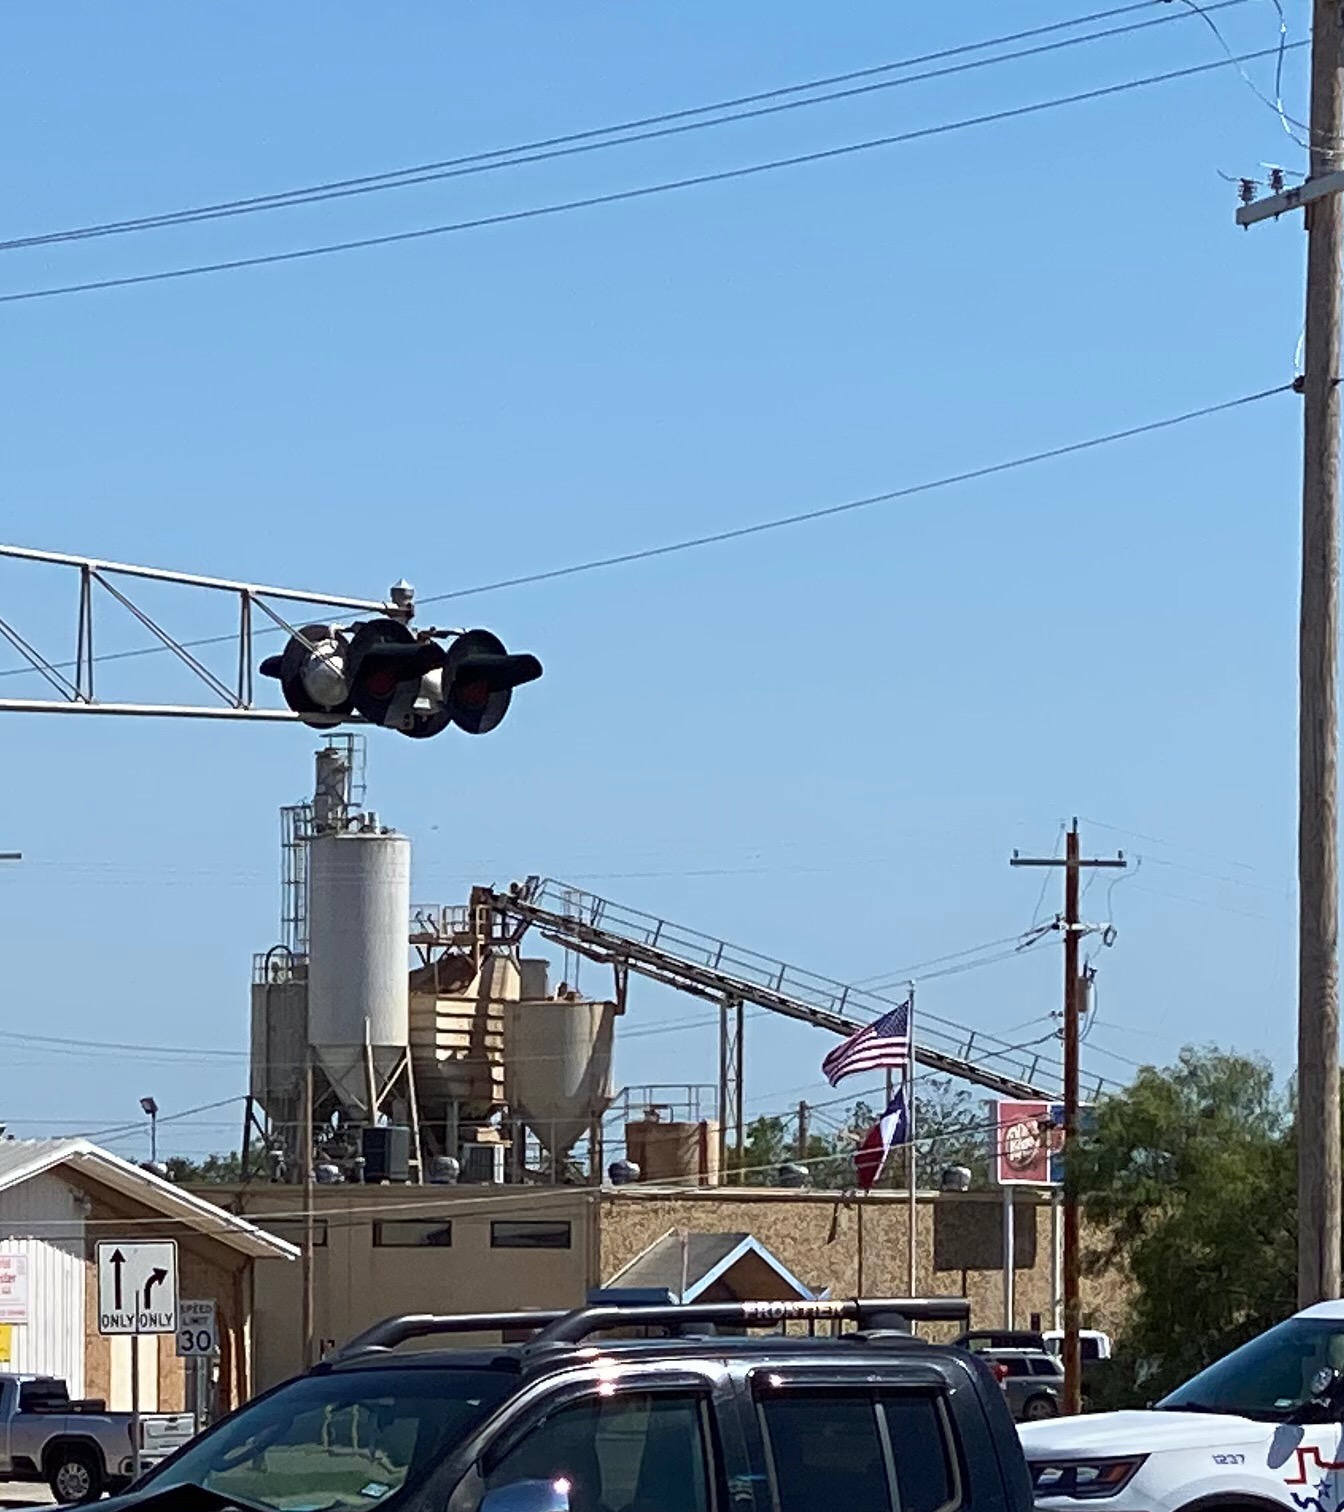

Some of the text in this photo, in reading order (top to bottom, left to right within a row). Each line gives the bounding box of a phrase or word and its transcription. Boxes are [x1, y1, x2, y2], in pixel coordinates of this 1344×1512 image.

[101, 1314, 135, 1329] ONLY
[140, 1312, 173, 1328] ONLY
[181, 1329, 212, 1352] 30
